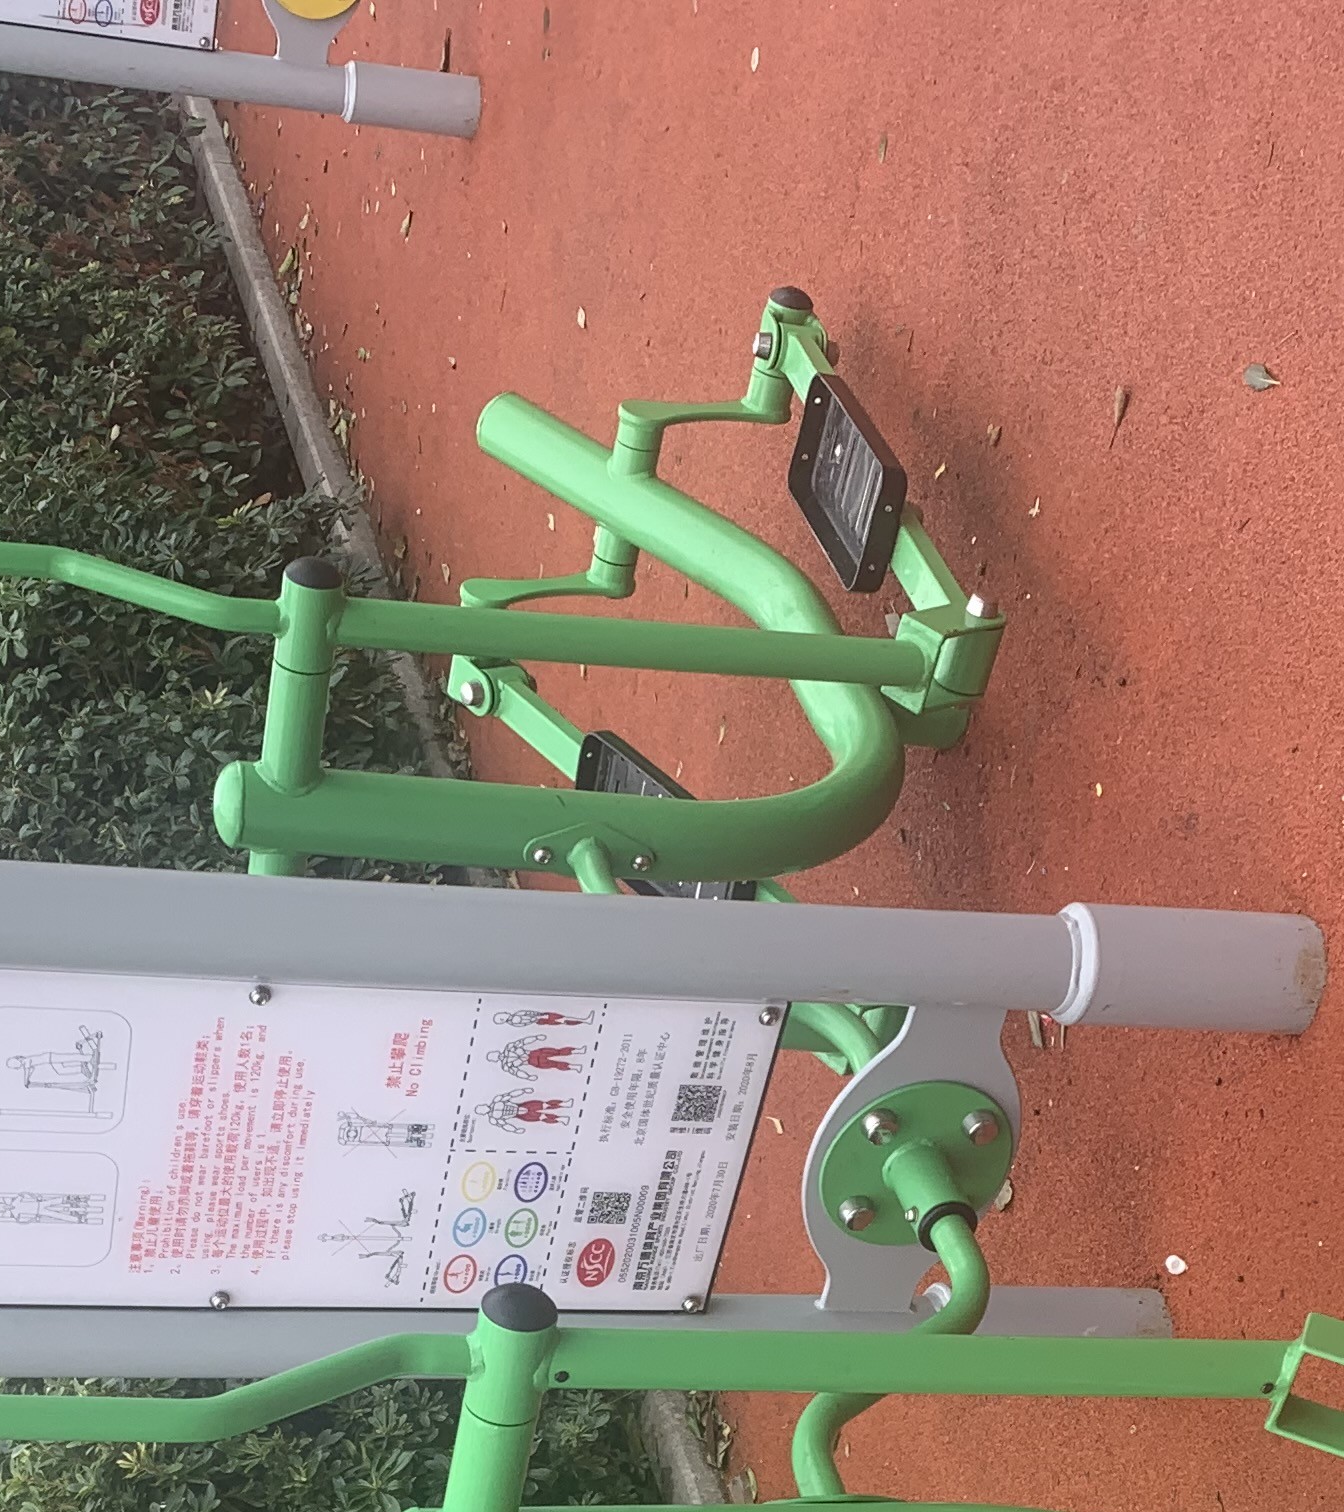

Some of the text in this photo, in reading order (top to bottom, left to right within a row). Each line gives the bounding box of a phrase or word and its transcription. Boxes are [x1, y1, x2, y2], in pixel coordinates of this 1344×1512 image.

[257, 1024, 268, 1043] and
[384, 1032, 411, 1089] 禁止攀爬
[404, 1018, 434, 1097] No Climbing
[249, 1087, 260, 1099] is
[286, 1083, 304, 1119] during
[184, 1016, 225, 1260] Please do not wear barefoot or slippers when
[243, 1105, 257, 1151] movement
[214, 1125, 227, 1160] sports
[255, 1143, 266, 1154] is
[278, 1123, 297, 1178] discomfort
[211, 1164, 221, 1187] wear
[240, 1154, 250, 1172] per
[252, 1159, 263, 1188] users
[280, 1089, 316, 1261] please stop using it immediately
[165, 1184, 177, 1197] of
[234, 1175, 248, 1196] load
[247, 1191, 258, 1204] of
[277, 1181, 289, 1199] any
[204, 1190, 218, 1224] please
[230, 1201, 243, 1240] maximum
[275, 1202, 284, 1213] is
[157, 1200, 176, 1259] Prohibition
[243, 1208, 256, 1240] number
[268, 1218, 282, 1245] there
[225, 1243, 238, 1260] The
[239, 1243, 251, 1260] the
[265, 1249, 277, 1259] If
[581, 1243, 606, 1282] NSCC
